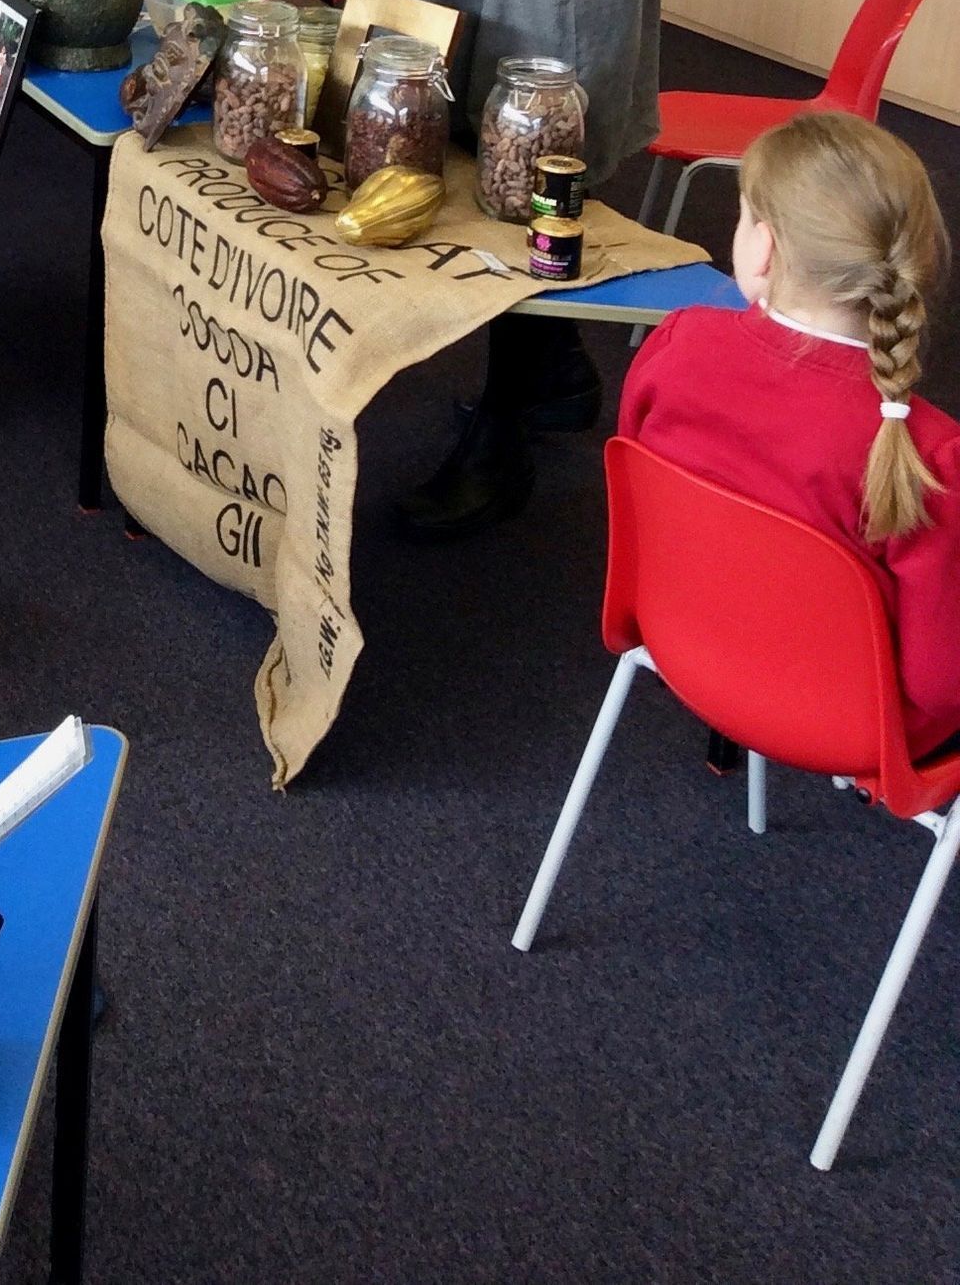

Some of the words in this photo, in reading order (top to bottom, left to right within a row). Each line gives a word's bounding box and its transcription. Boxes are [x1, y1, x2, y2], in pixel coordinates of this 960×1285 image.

[158, 157, 338, 251] PRODUCE
[313, 254, 406, 284] OF
[139, 185, 208, 276] COTE
[207, 233, 355, 375] D'IVOIRE
[172, 283, 280, 393] COCOA
[205, 377, 238, 438] CI
[176, 421, 288, 516] CACAO
